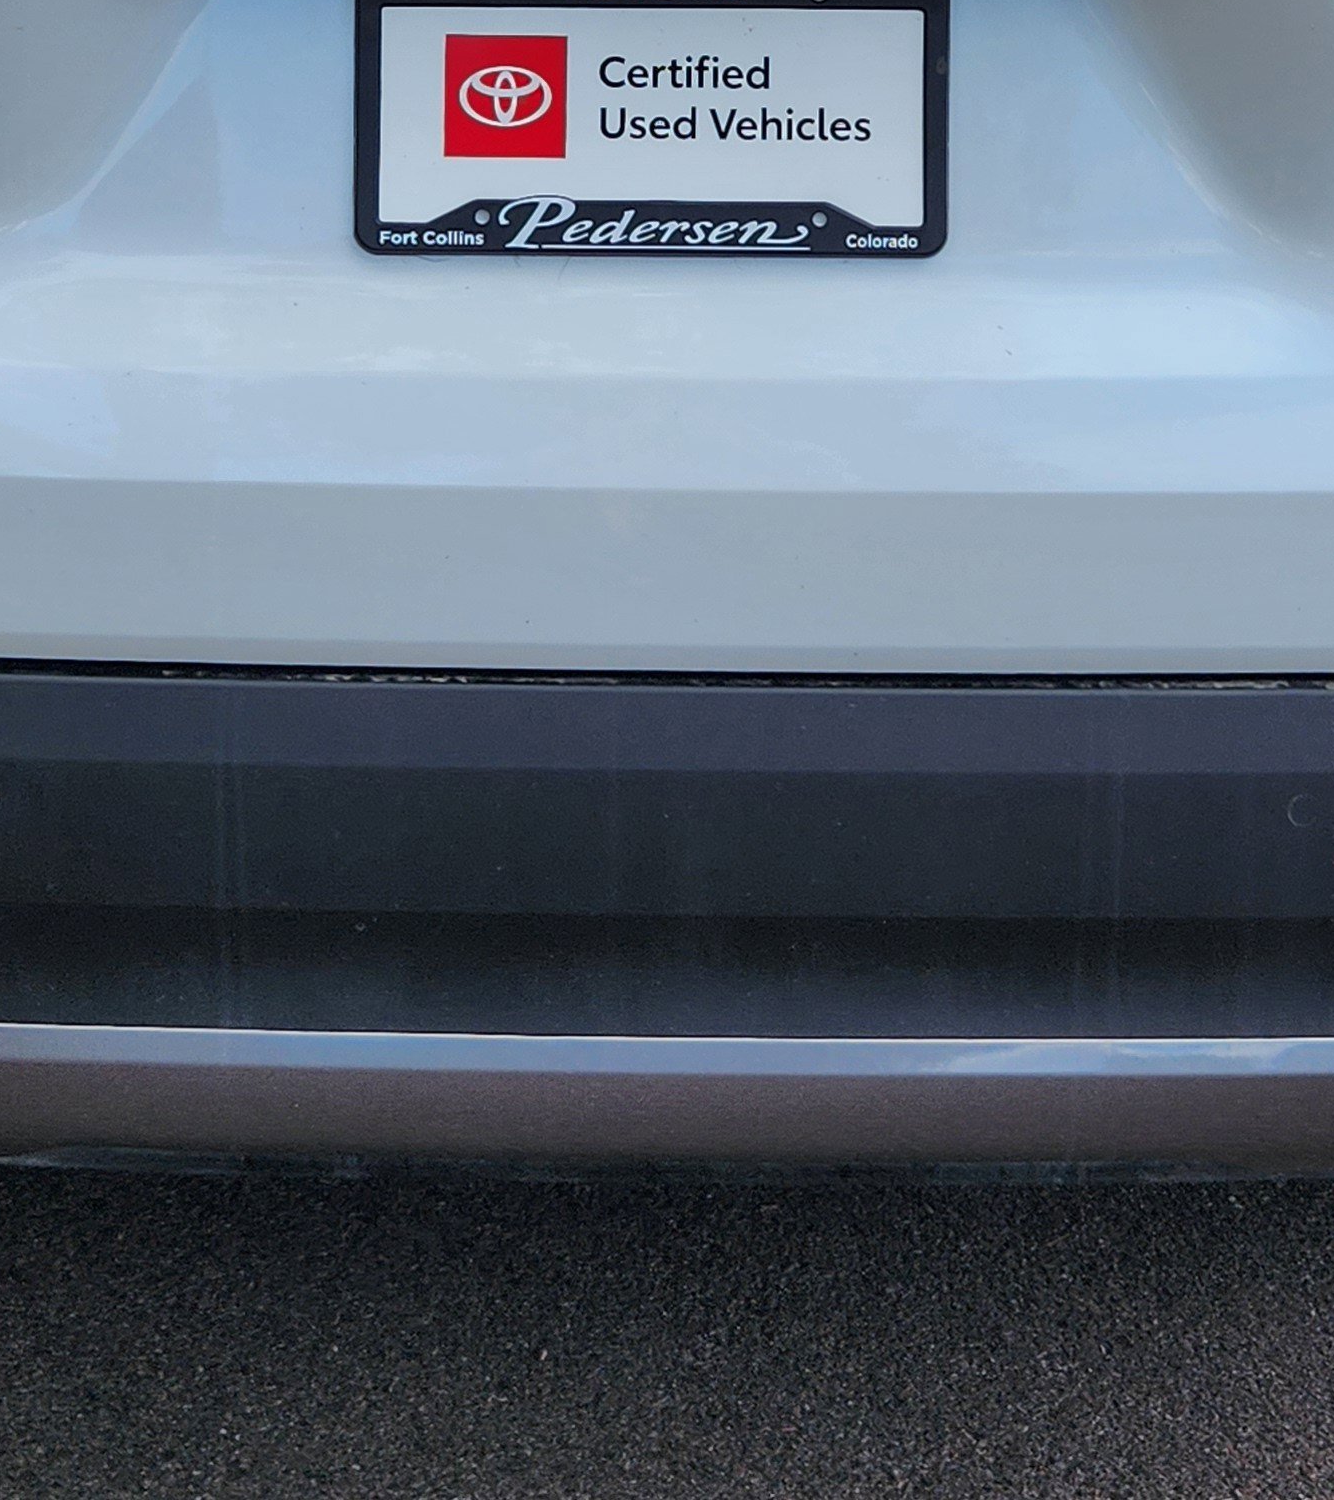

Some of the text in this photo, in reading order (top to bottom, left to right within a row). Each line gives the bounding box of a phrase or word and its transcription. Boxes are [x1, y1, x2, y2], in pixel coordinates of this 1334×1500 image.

[598, 55, 771, 89] Certified
[599, 106, 872, 141] Used Vehicles
[378, 230, 485, 247] Fort Collins
[497, 197, 810, 249] Pedersen
[844, 233, 919, 249] Colorado
